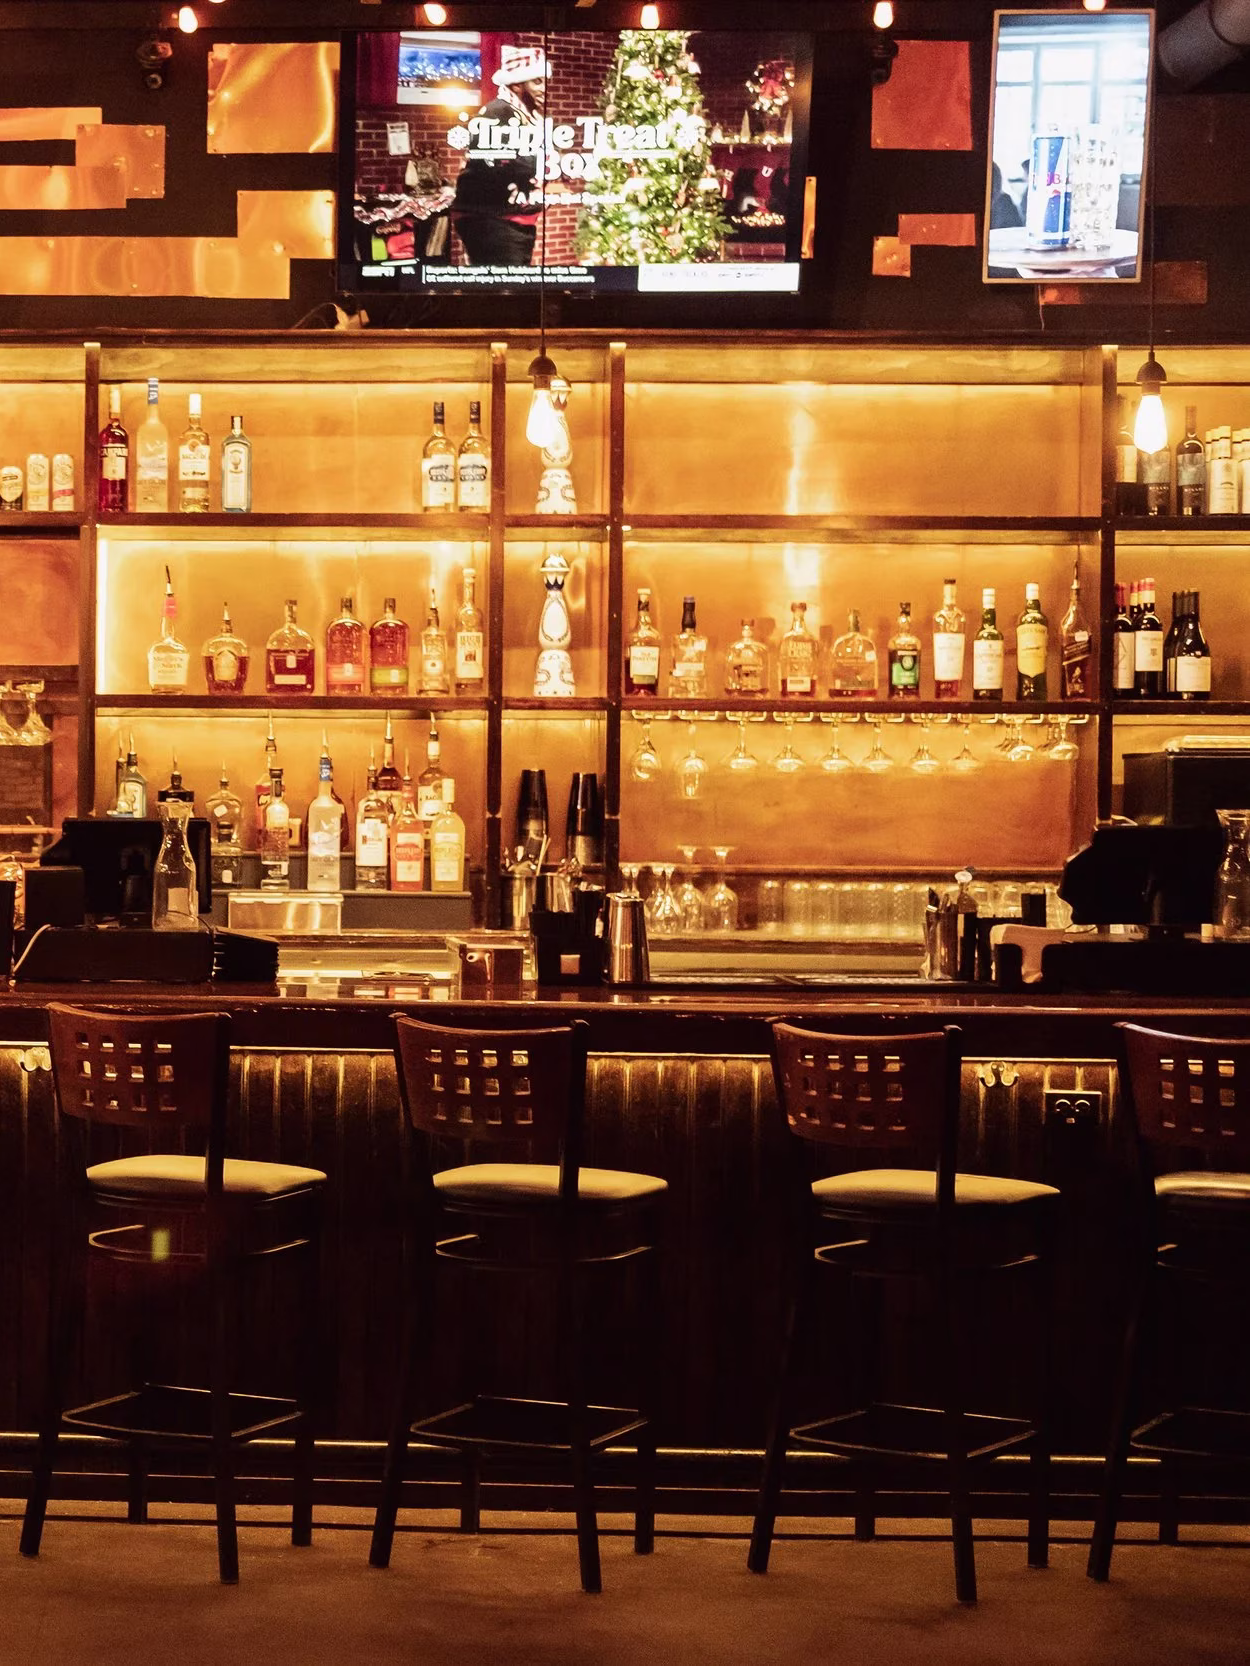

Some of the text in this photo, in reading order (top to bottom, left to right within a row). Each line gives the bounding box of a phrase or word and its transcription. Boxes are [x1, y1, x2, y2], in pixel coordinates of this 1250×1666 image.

[467, 116, 672, 156] Triple Treat
[535, 149, 603, 182] Box
